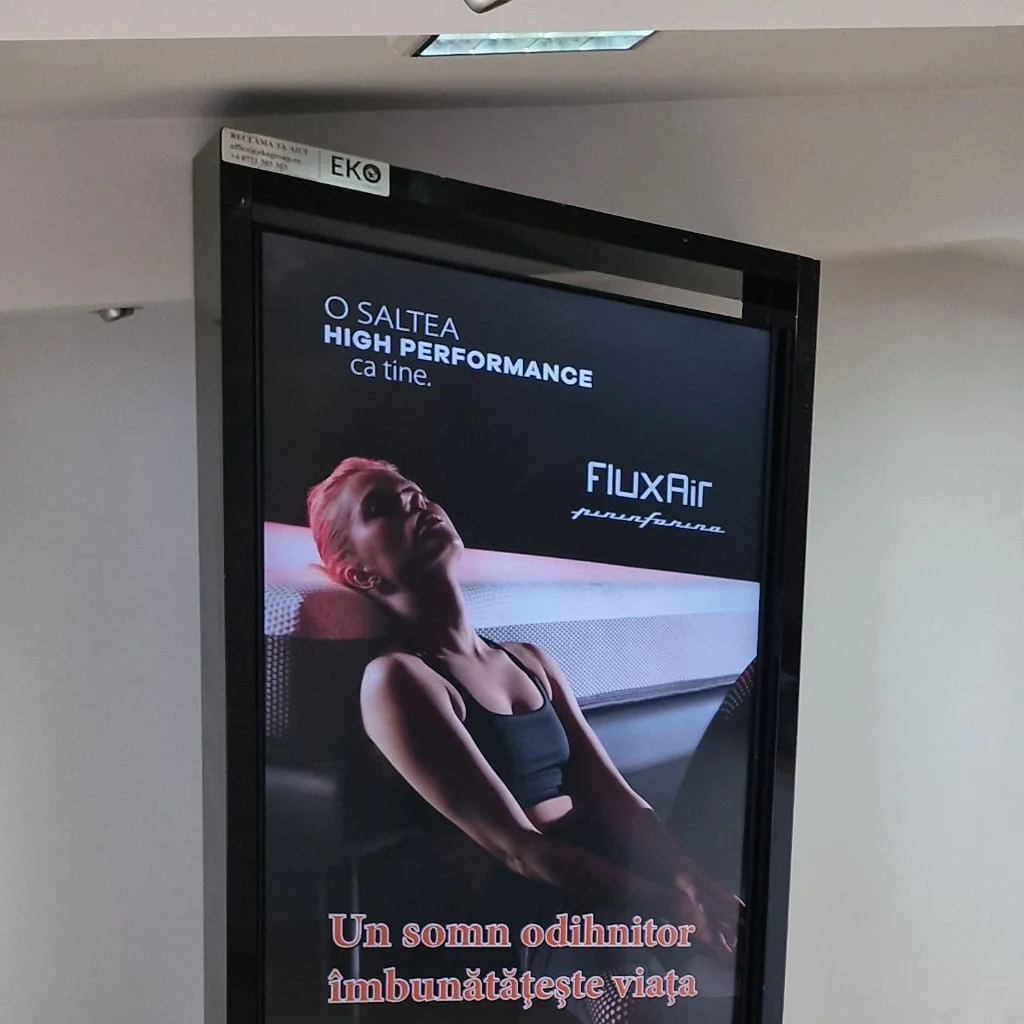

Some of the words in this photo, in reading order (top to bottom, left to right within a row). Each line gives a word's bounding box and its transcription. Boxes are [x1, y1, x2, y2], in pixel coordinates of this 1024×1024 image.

[331, 155, 382, 184] EKO
[324, 295, 349, 320] O
[357, 301, 460, 341] SALTEA
[324, 324, 391, 355] HIGH
[400, 337, 594, 389] PERFORMANCE
[350, 358, 376, 378] ca
[382, 359, 432, 388] tine.
[570, 507, 727, 534] pininfarina
[328, 913, 392, 948] Un
[401, 921, 512, 948] somn
[520, 913, 695, 948] odihnitor
